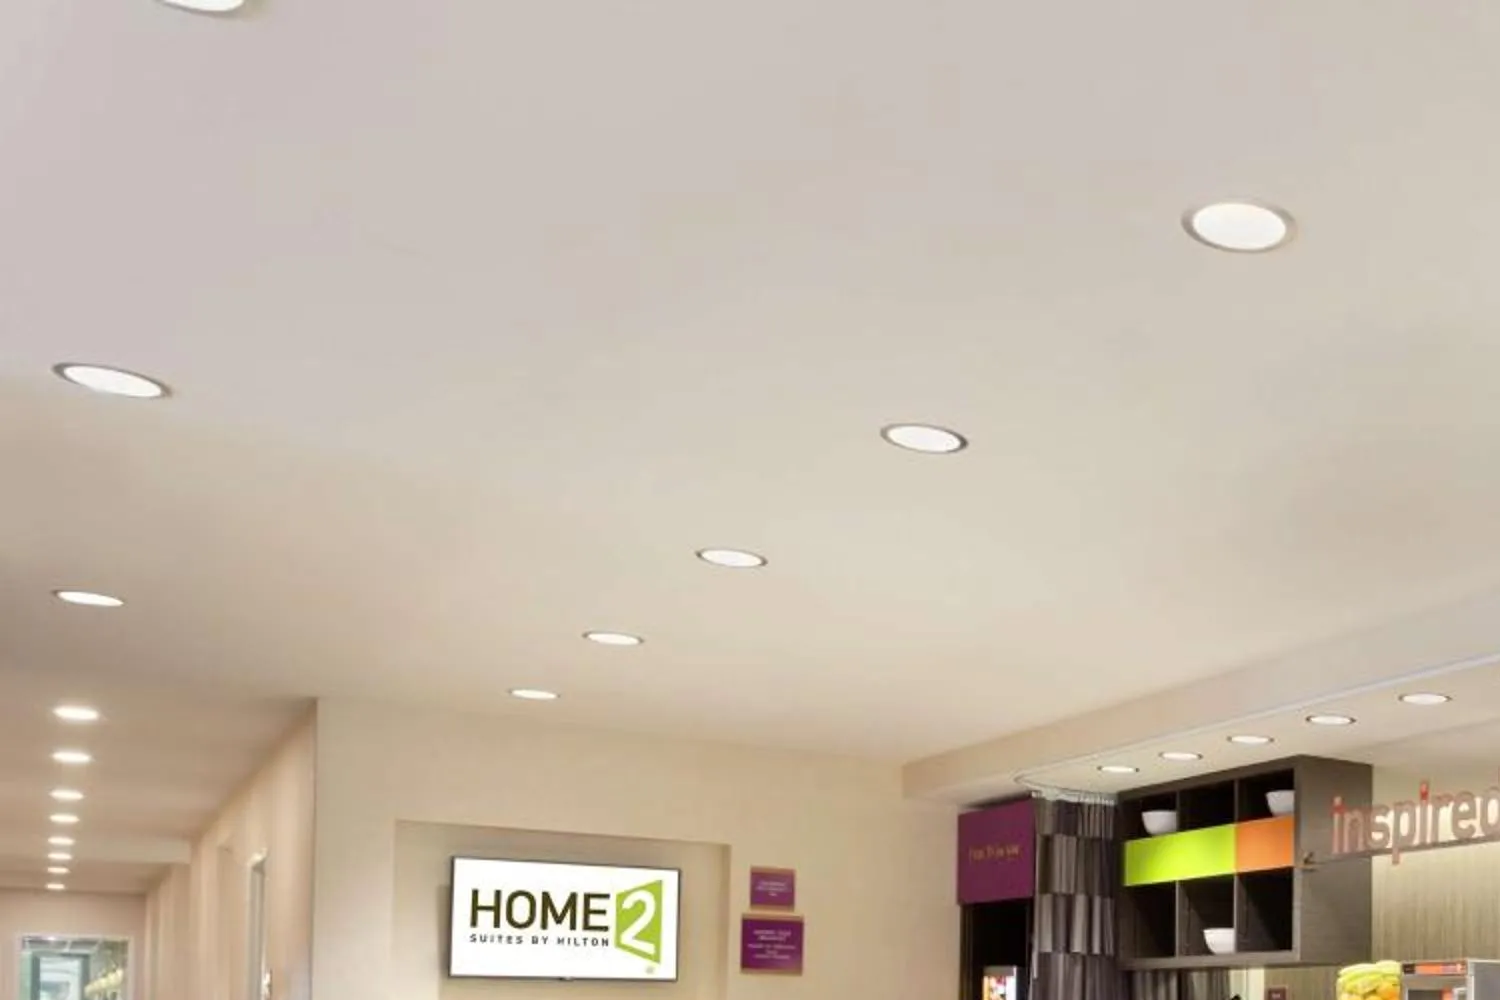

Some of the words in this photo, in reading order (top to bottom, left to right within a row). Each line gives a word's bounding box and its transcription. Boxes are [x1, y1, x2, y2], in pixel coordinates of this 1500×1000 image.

[469, 933, 524, 945] SUITES
[531, 935, 549, 945] BY
[557, 936, 610, 947] HILTON
